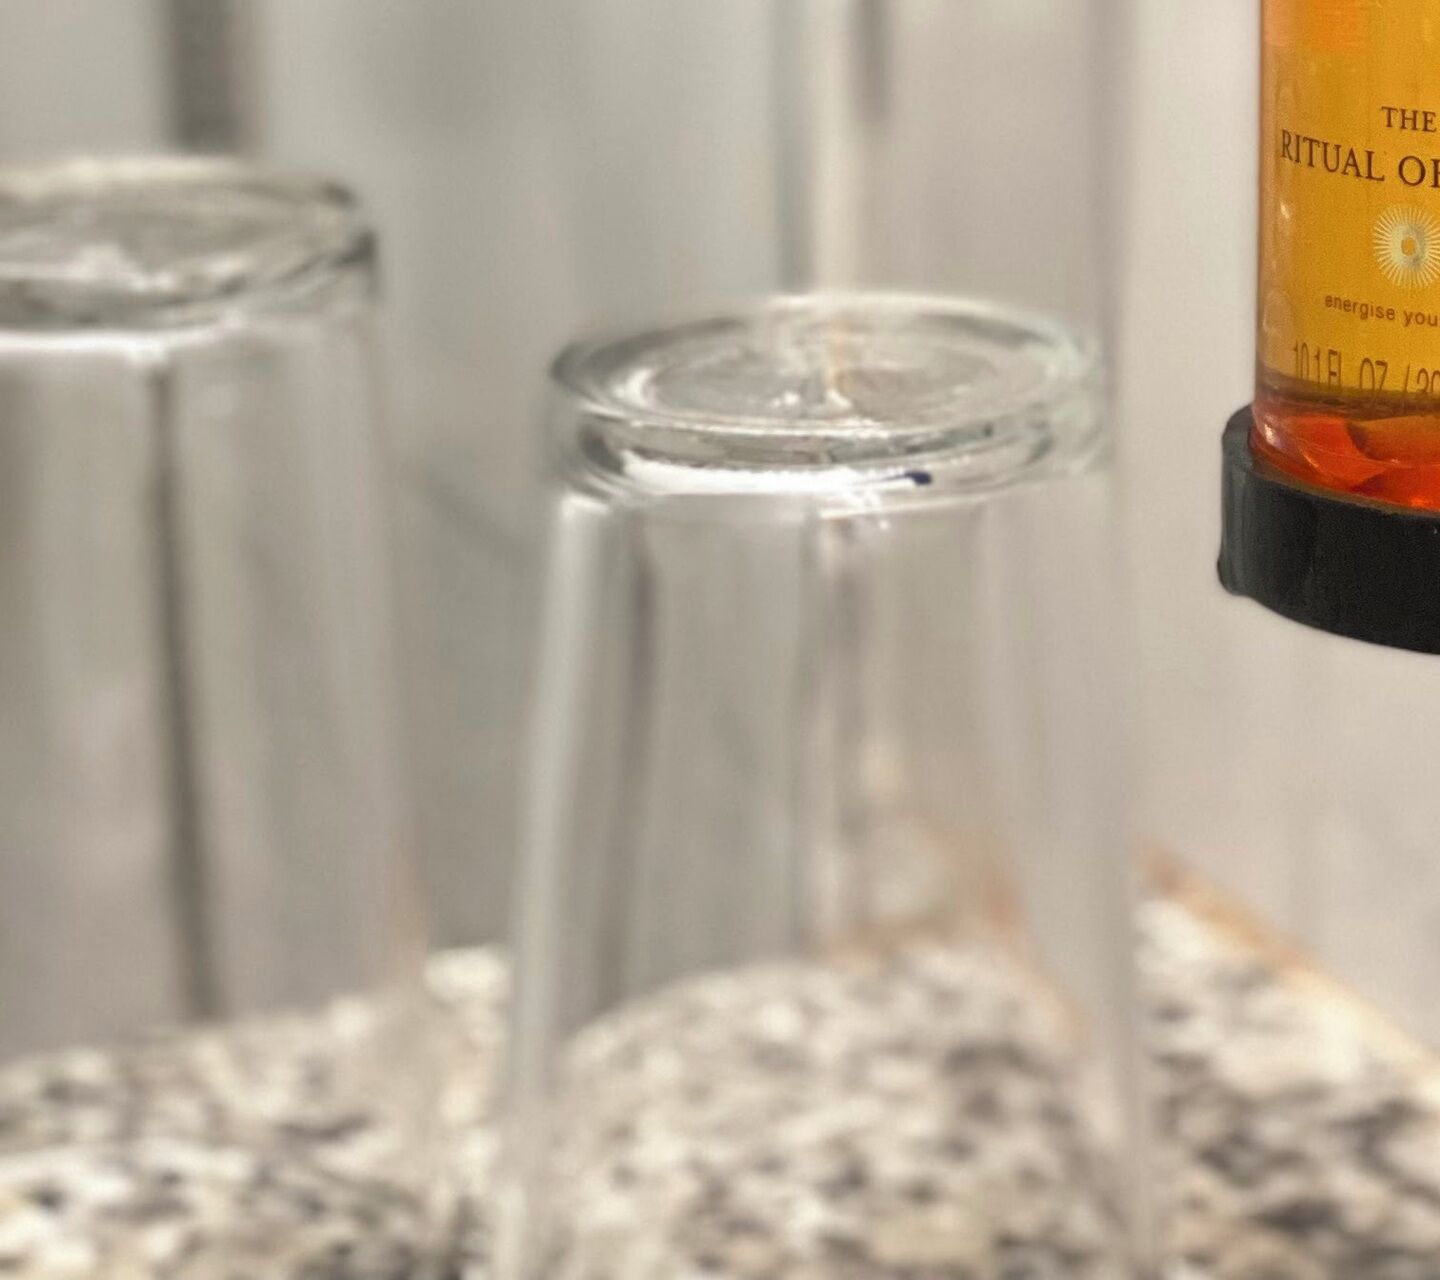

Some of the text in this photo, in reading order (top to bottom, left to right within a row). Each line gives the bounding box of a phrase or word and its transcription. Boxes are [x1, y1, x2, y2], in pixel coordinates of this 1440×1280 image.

[1380, 105, 1438, 133] THE
[1279, 128, 1385, 182] RITUAL
[1324, 294, 1396, 321] energise
